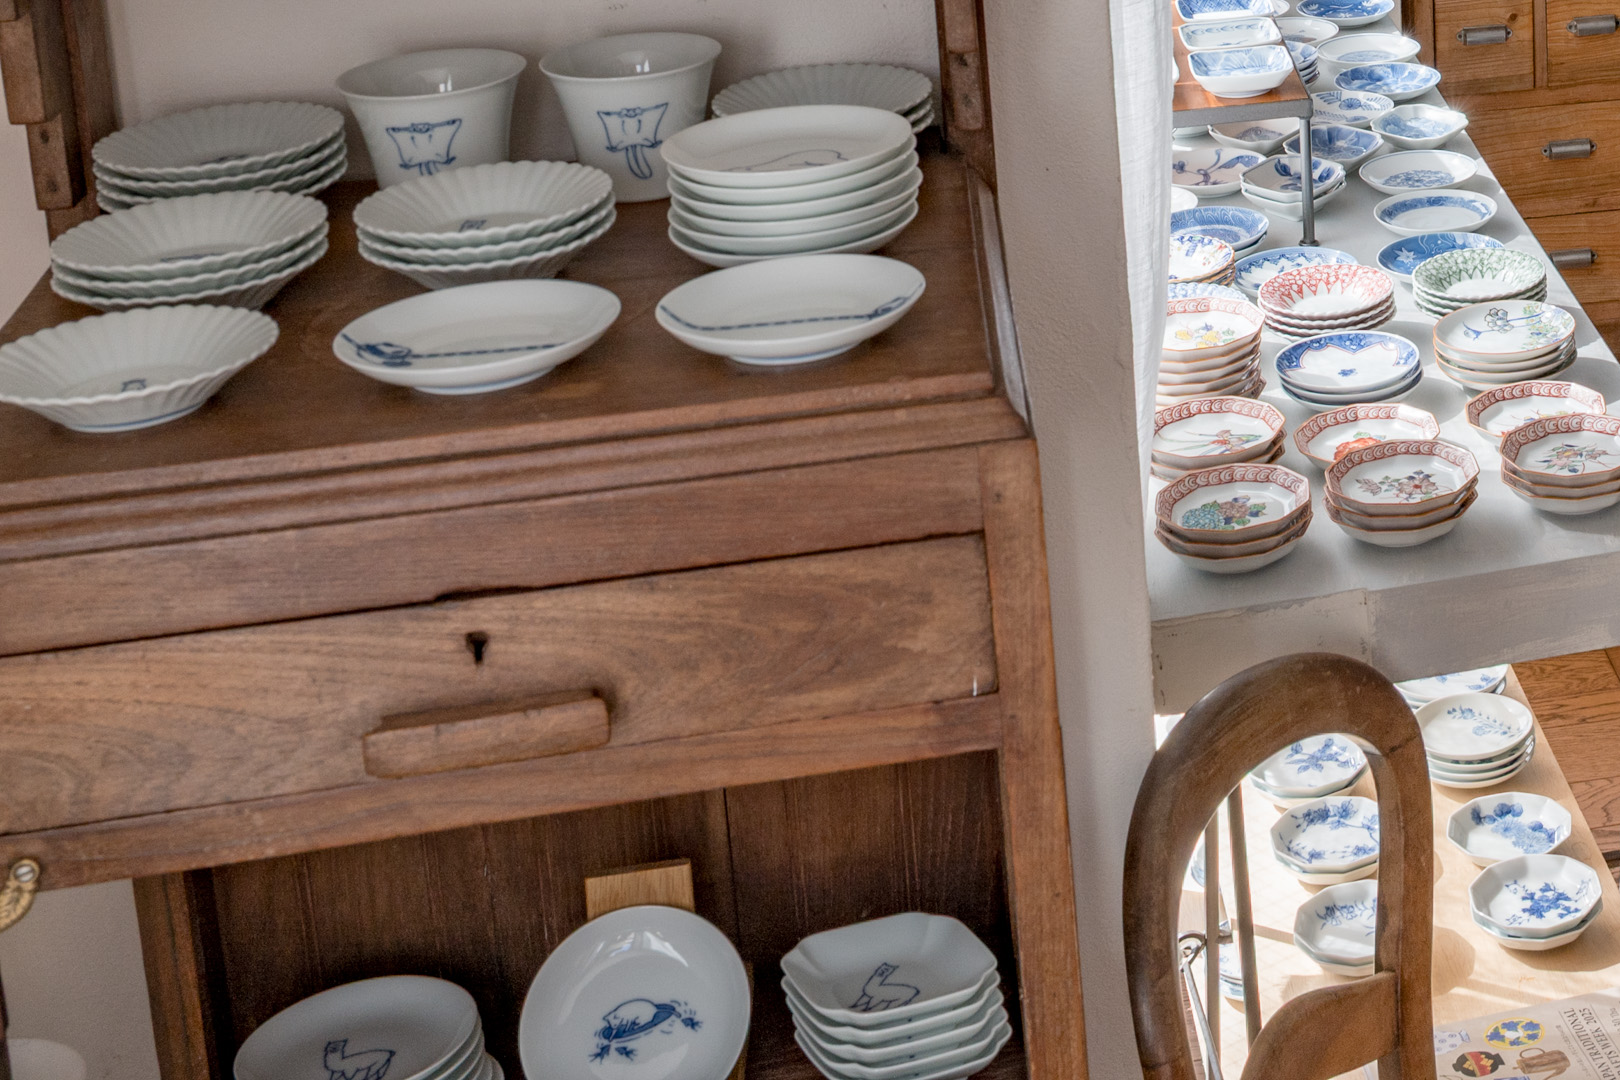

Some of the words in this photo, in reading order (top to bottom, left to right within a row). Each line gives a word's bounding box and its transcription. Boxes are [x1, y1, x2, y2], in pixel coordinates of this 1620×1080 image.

[1578, 1007, 1597, 1025] 2025
[1563, 1007, 1603, 1062] TRADITIONAL
[1590, 1026, 1613, 1051] WEEK
